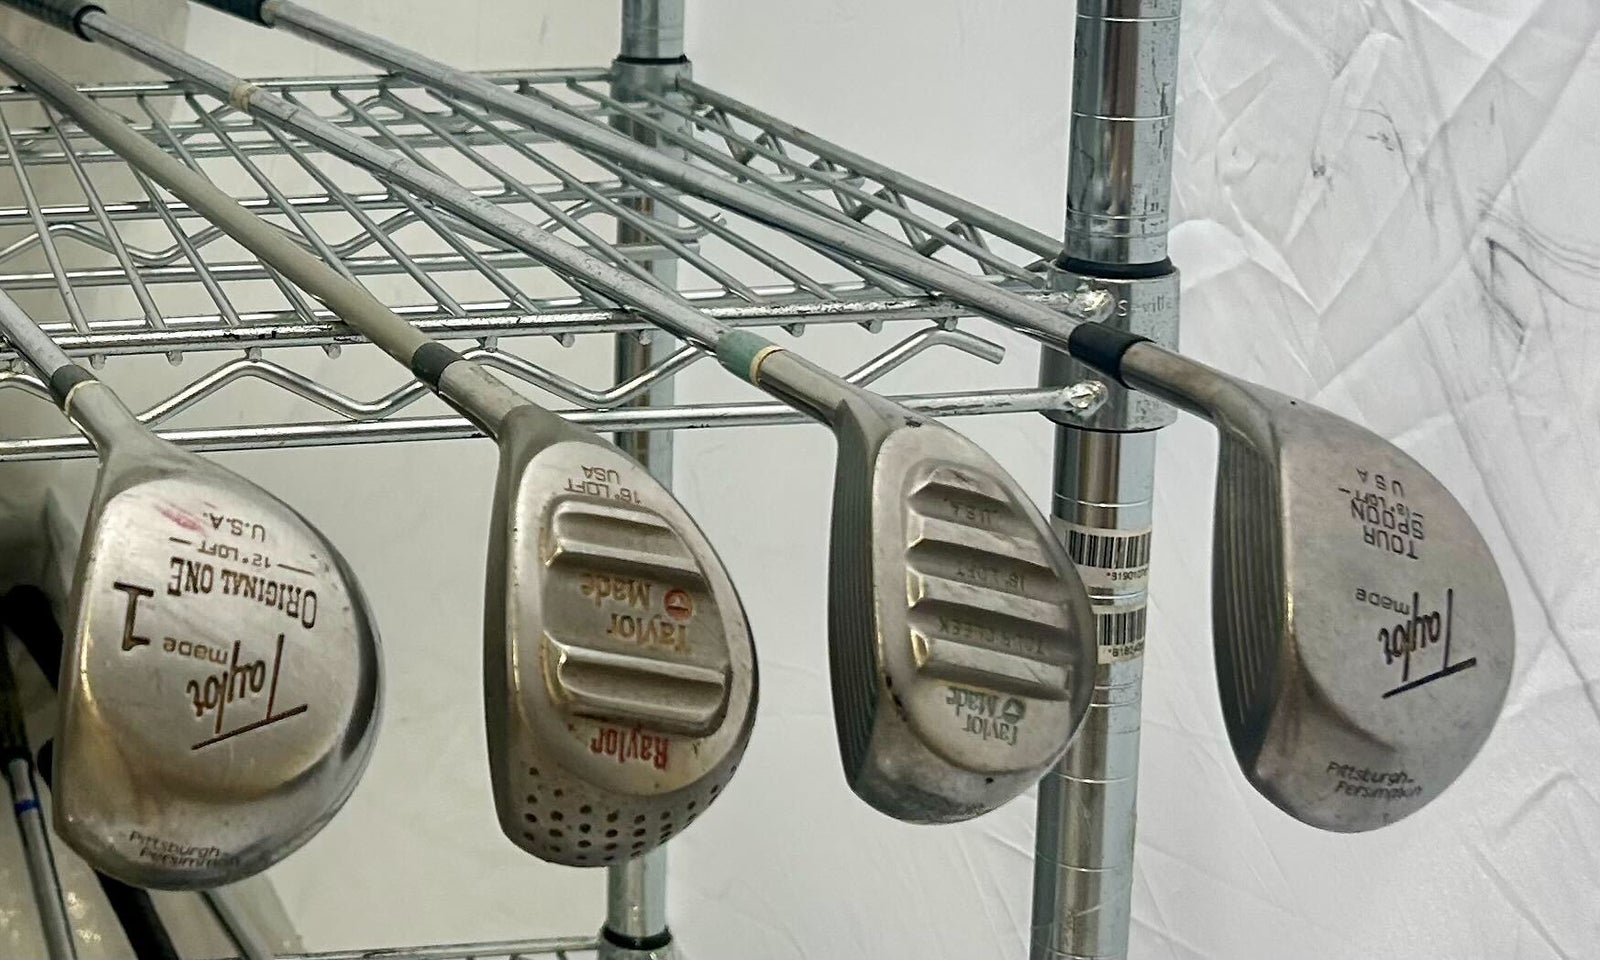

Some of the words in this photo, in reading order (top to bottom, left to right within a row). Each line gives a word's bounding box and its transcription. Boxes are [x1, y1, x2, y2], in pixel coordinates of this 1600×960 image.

[563, 478, 610, 499] LOFT
[580, 464, 621, 486] USA
[1355, 467, 1404, 499] USA
[202, 512, 265, 543] U.S.A.
[1350, 499, 1424, 541] SPOON
[196, 540, 240, 561] LOFT
[1362, 525, 1419, 561] TOUR
[167, 556, 214, 597] ONE
[579, 572, 652, 612] Made
[113, 581, 156, 653] 1
[221, 568, 318, 630] ORIGINAL
[1354, 588, 1410, 617] made
[163, 639, 229, 667] made
[606, 613, 692, 657] Taylor
[1378, 588, 1477, 700] Taylor
[187, 634, 308, 751] Taylor
[945, 687, 997, 719] Made
[590, 725, 670, 772] Raylor
[962, 716, 1019, 747] Taylor
